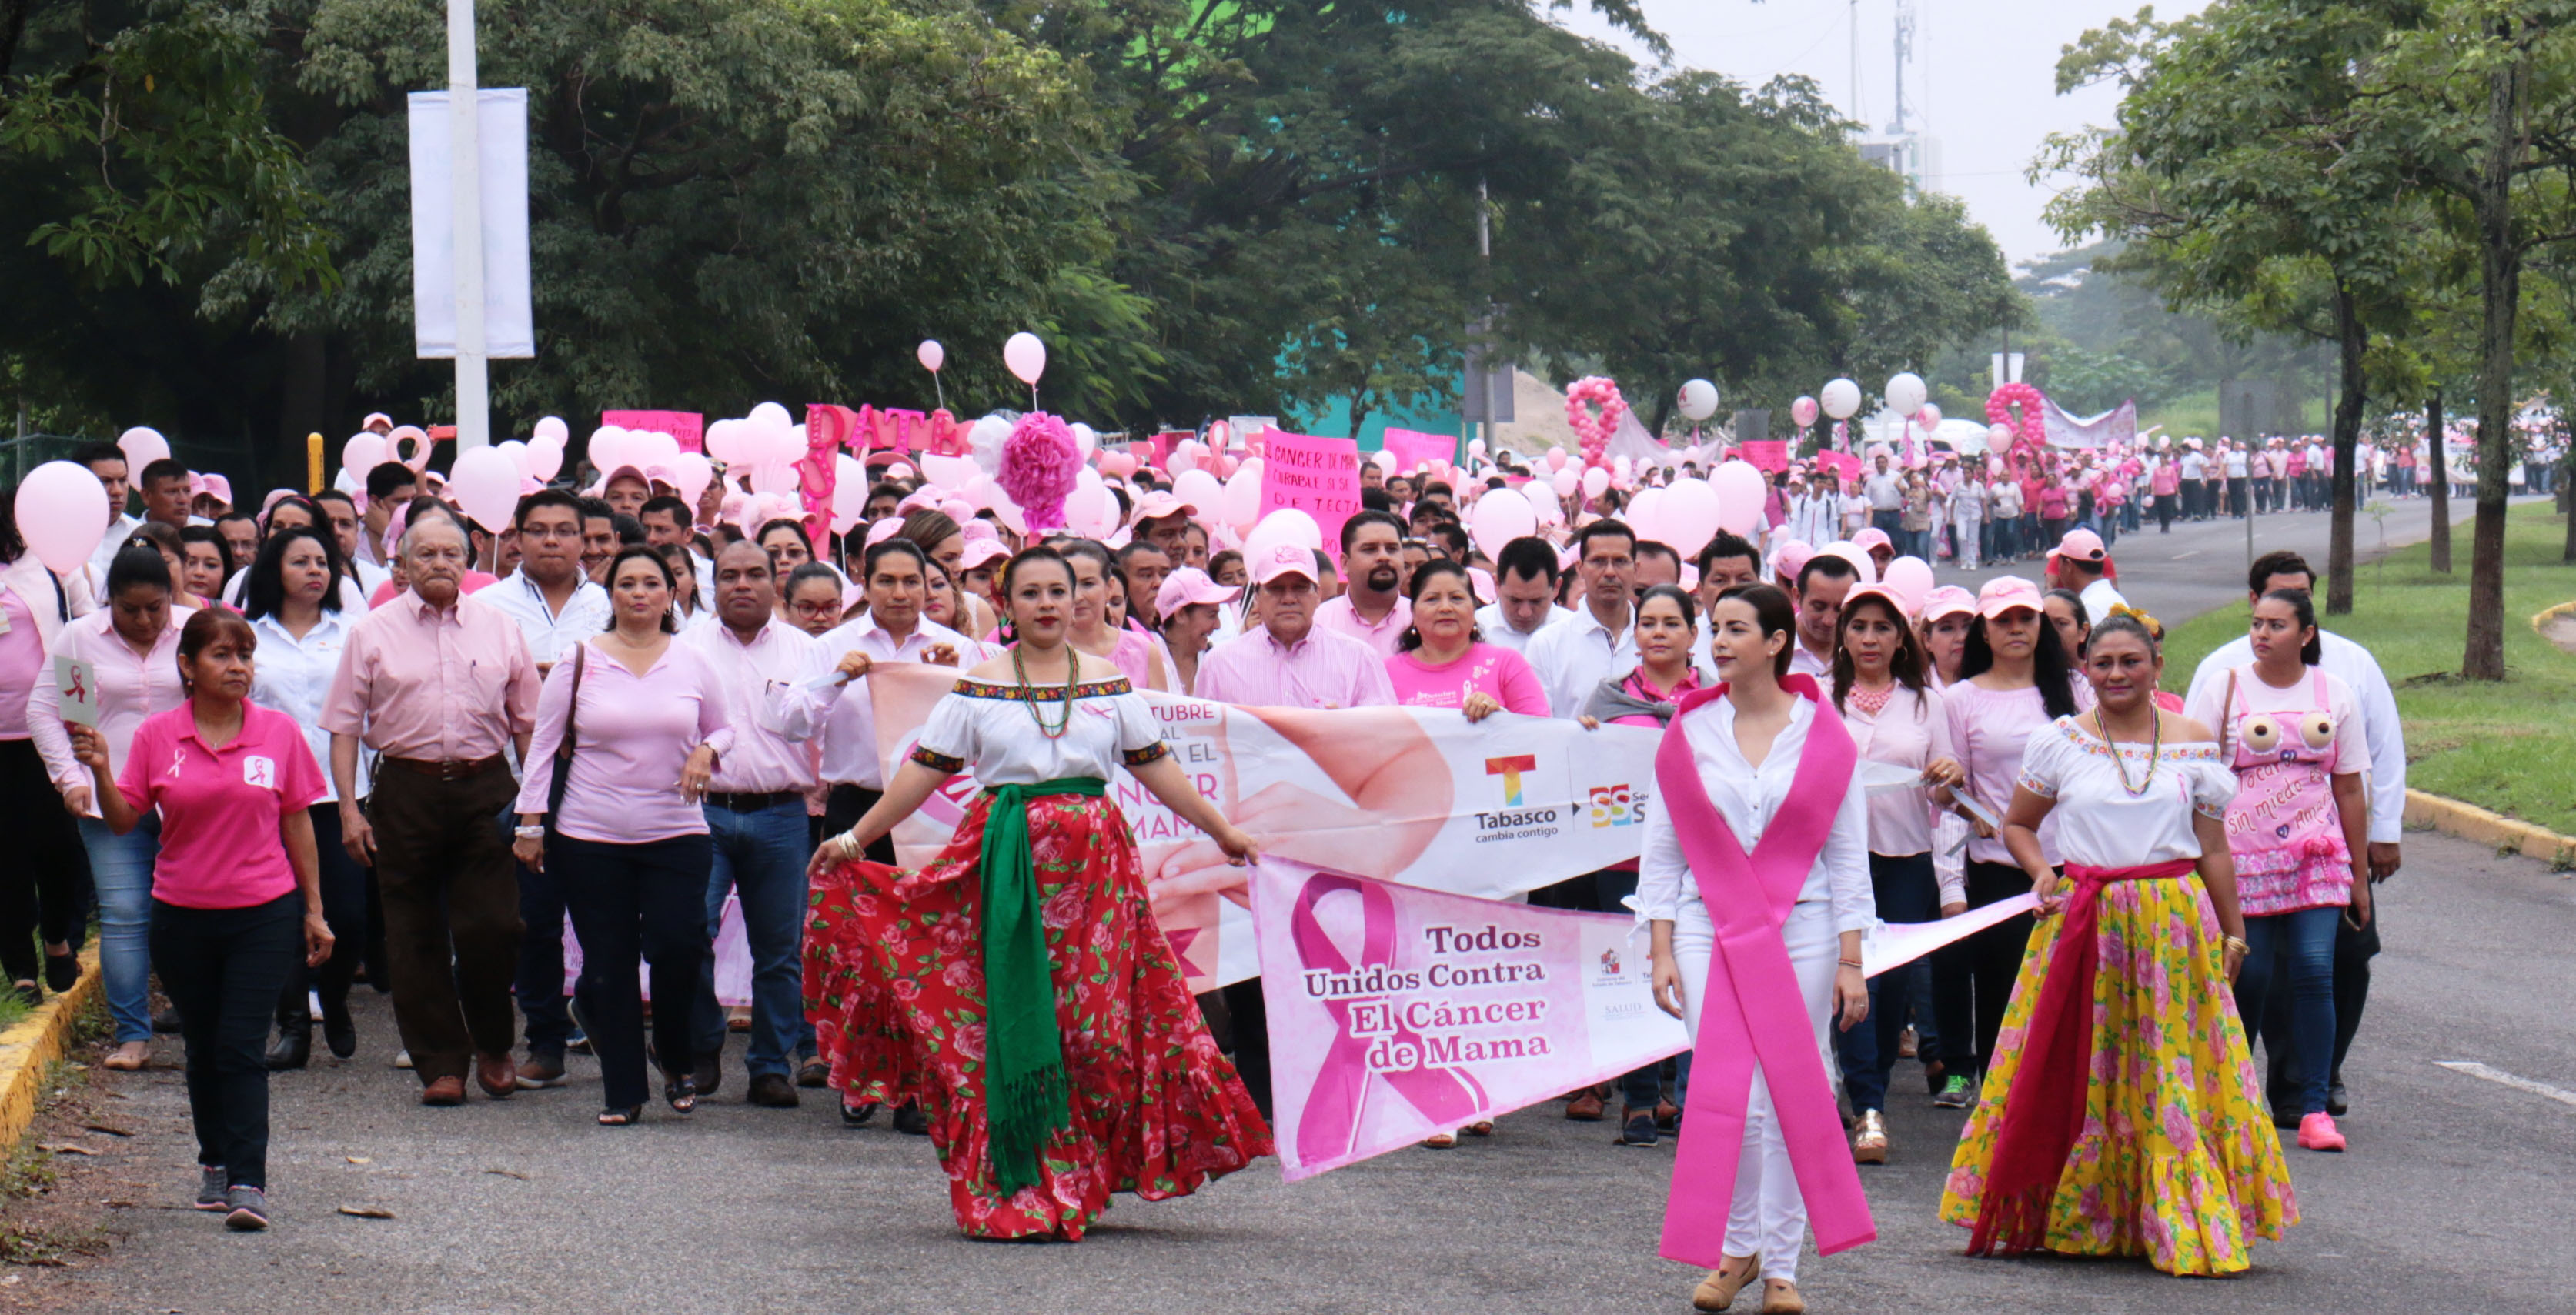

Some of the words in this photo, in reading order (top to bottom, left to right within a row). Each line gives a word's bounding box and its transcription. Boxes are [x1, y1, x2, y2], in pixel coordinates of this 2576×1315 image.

[1275, 446, 1323, 469] CANCER
[1273, 468, 1320, 490] CURABLE
[1151, 703, 1215, 723] TUBRE
[1161, 726, 1181, 741] AL
[1189, 743, 1218, 763] EL
[2228, 809, 2257, 835] sin
[2255, 777, 2303, 819] miedo
[1475, 809, 1557, 830] Tabasco
[1475, 829, 1515, 843] cambia
[1517, 826, 1559, 839] contigo
[1426, 926, 1541, 953] Todos
[1305, 968, 1420, 996] Unidos
[1428, 962, 1545, 987] Contra
[1352, 1003, 1393, 1033] El
[1406, 1000, 1546, 1029] Cáncer
[1368, 1041, 1414, 1068] de
[1426, 1036, 1551, 1064] Mama
